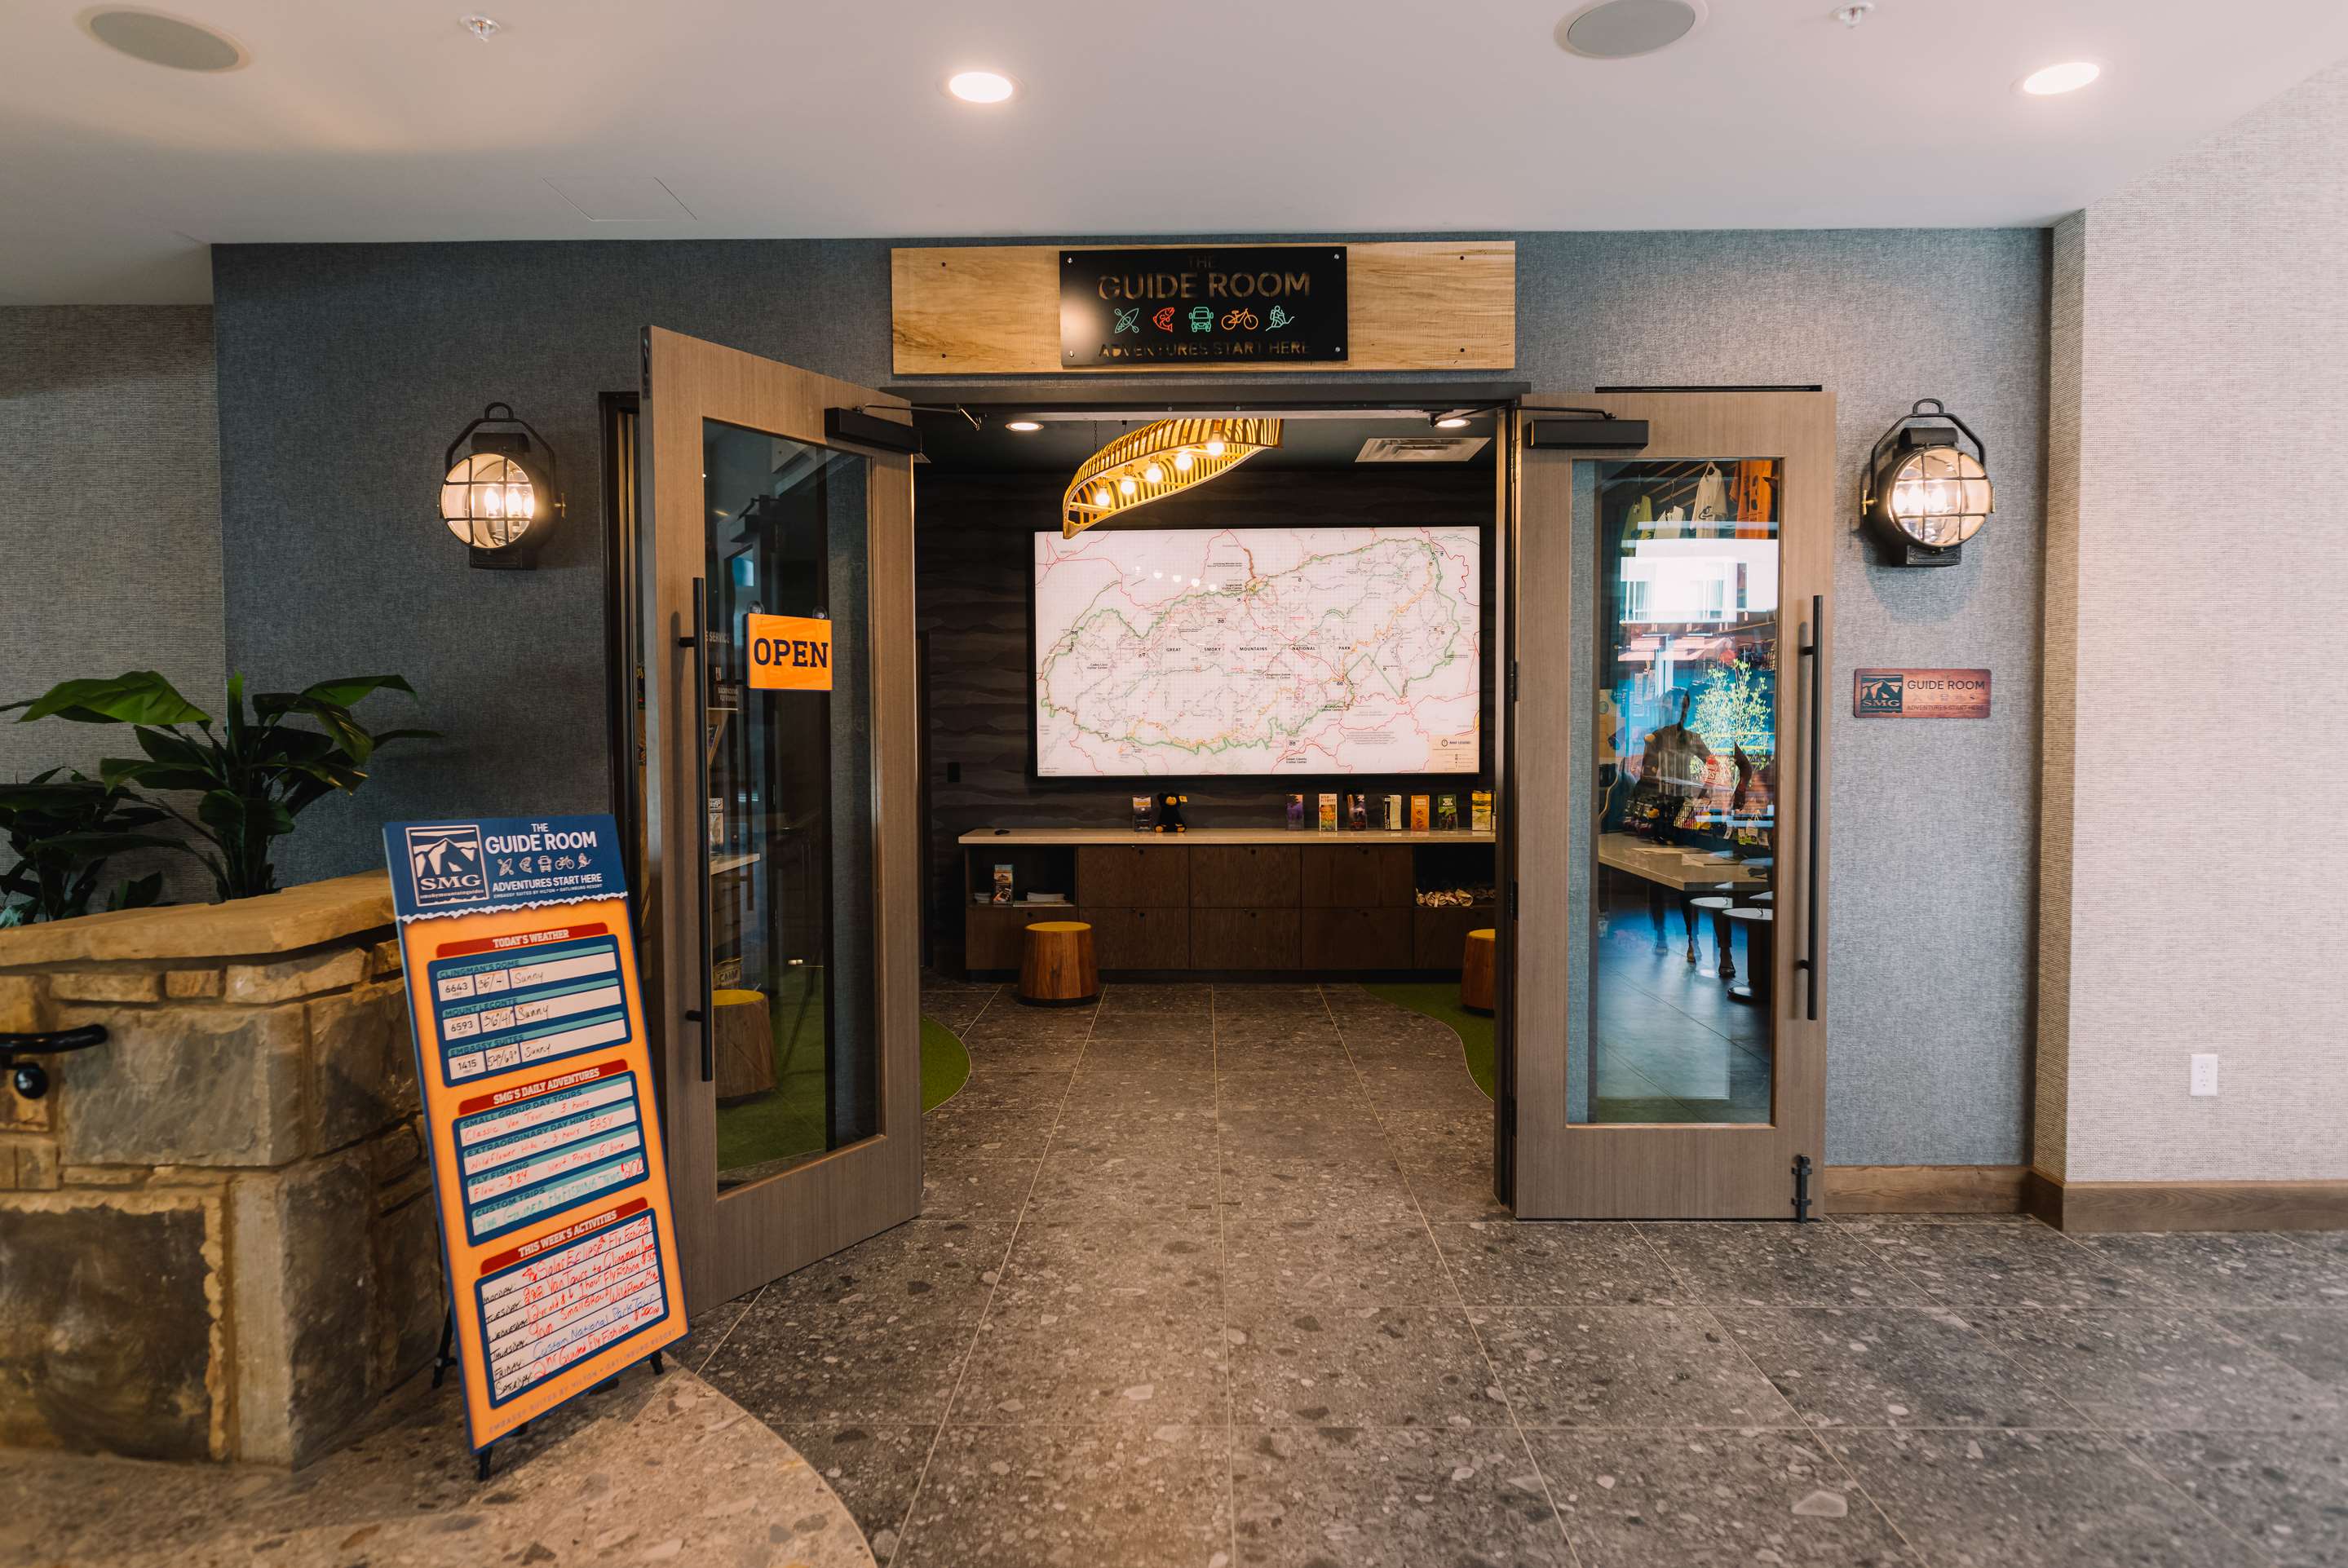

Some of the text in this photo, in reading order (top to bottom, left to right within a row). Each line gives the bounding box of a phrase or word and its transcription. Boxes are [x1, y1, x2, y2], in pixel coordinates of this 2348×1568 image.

[1187, 254, 1215, 268] THE
[1098, 271, 1311, 301] GUIDE ROOM
[754, 638, 829, 668] OPEN
[1907, 679, 1985, 690] GUIDE ROOM
[530, 823, 549, 833] THE
[485, 831, 598, 855] GUIDE ROOM
[420, 874, 483, 890] SMG
[493, 873, 603, 892] ADVENTURES START HERE
[420, 889, 484, 899] smokymountainguides
[493, 929, 570, 948] TODAY'S WEATHER
[439, 959, 520, 978] CLINGMAN'S DOME
[514, 971, 544, 985] Sunny
[445, 983, 469, 993] 6643
[444, 1004, 480, 1018] MOUNT
[515, 1005, 549, 1021] Sunny
[451, 1020, 473, 1032] 6593
[449, 1034, 524, 1054] EMBASSY SUITES
[524, 1043, 551, 1058] Sunny
[458, 1059, 477, 1071] 1415
[493, 1067, 600, 1105] SMG'S DAILY ADVENTURES
[462, 1089, 582, 1129] SMALL GROUP DAY TOURS
[467, 1112, 595, 1157] EXTRAORDINARY DAY HIKES
[471, 1161, 529, 1186] FLY FISHING
[475, 1186, 546, 1217] CUSTOM TRIPS
[517, 1209, 617, 1258] THIS WEEK'S ACTIVITIES
